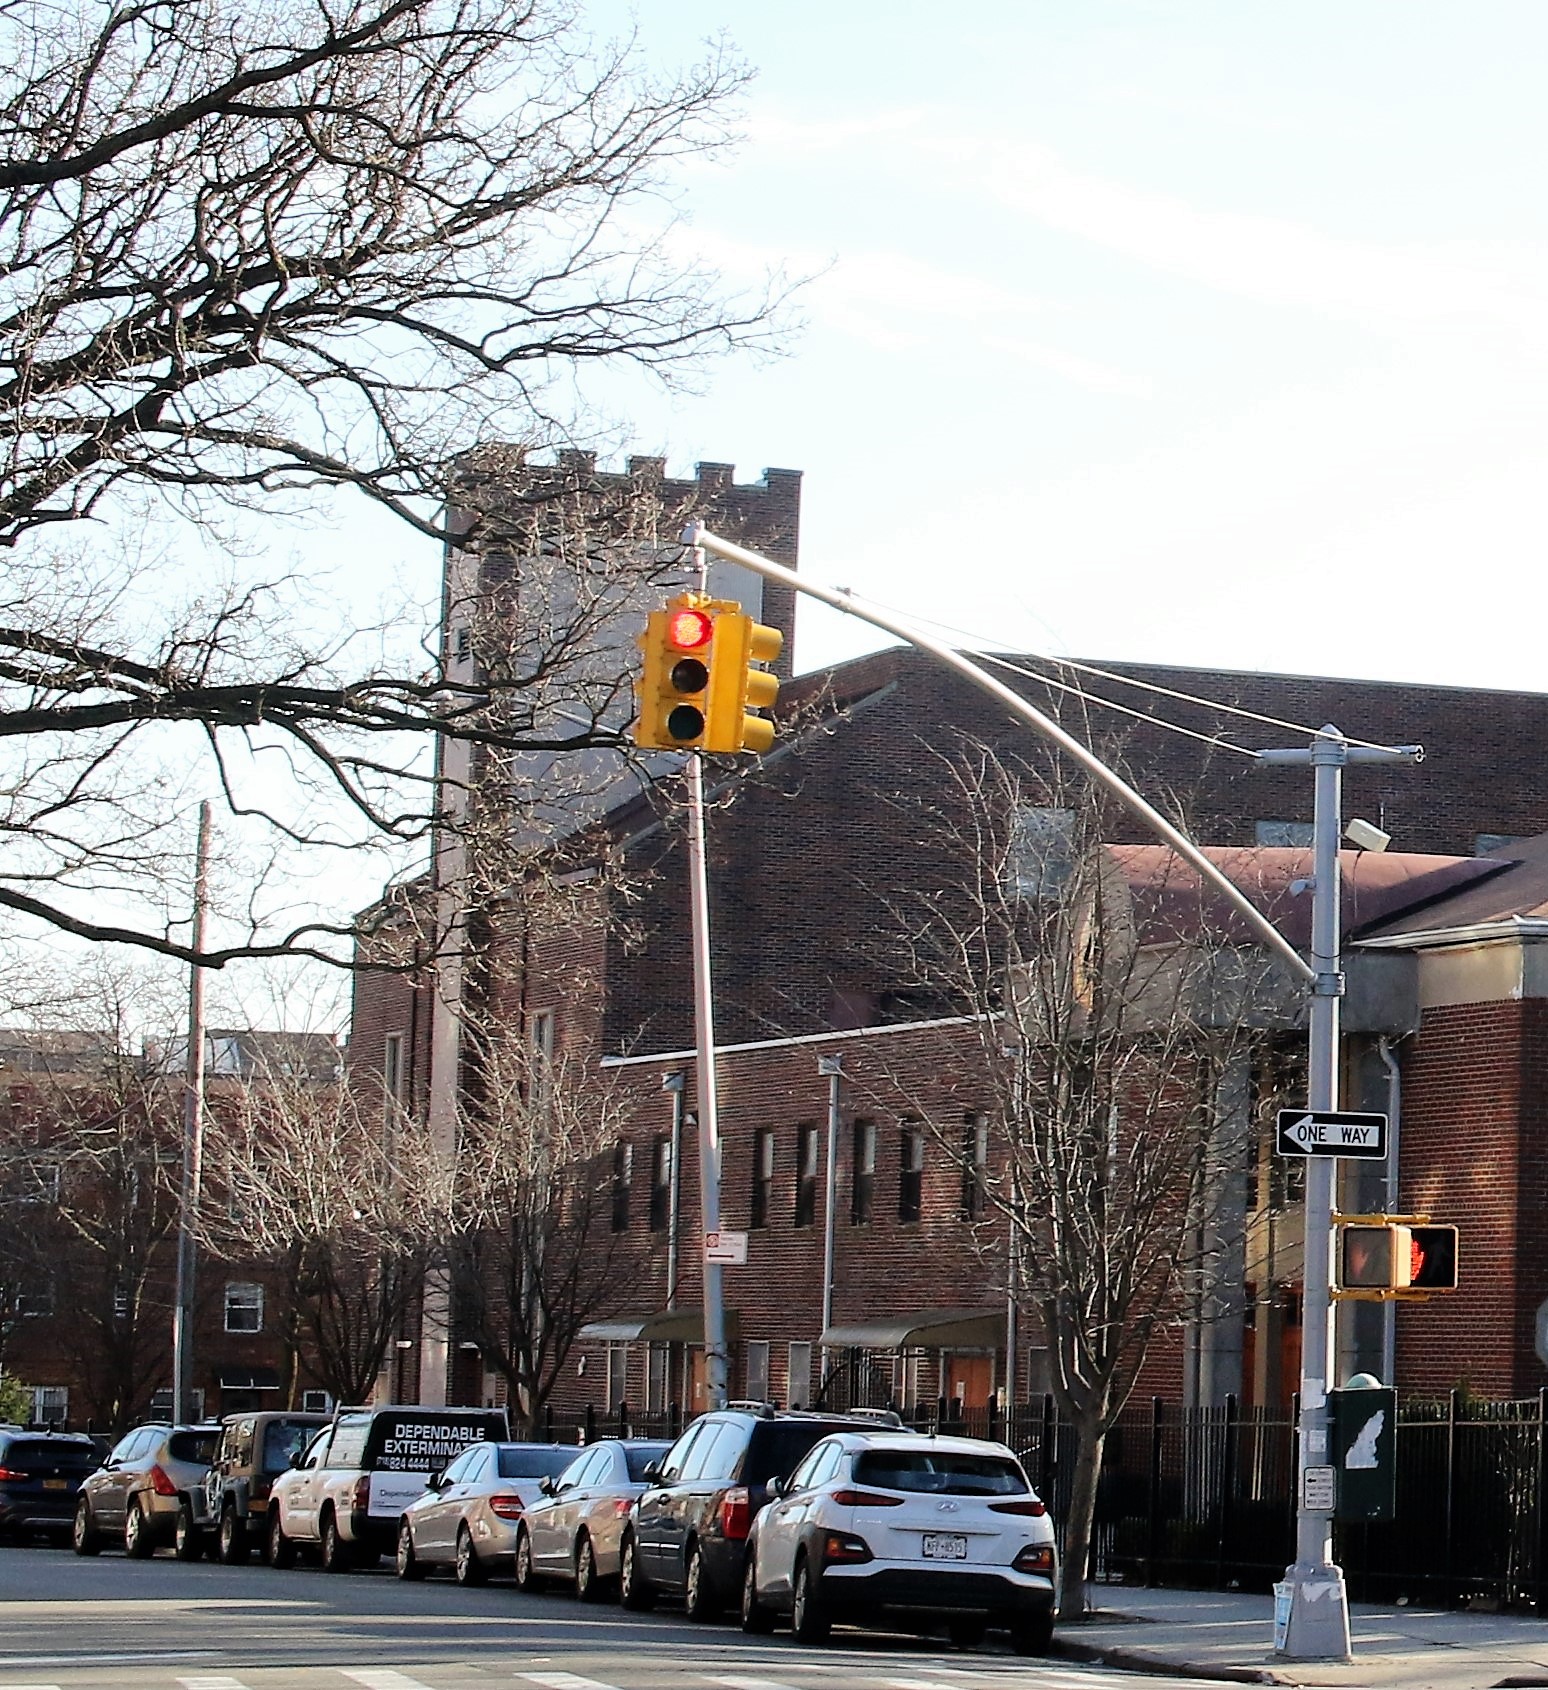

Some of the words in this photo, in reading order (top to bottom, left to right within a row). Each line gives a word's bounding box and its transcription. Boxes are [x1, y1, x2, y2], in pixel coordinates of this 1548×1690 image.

[1297, 1125, 1327, 1142] ONE
[1341, 1127, 1370, 1144] WAY
[395, 1424, 485, 1441] DEPENDABLE
